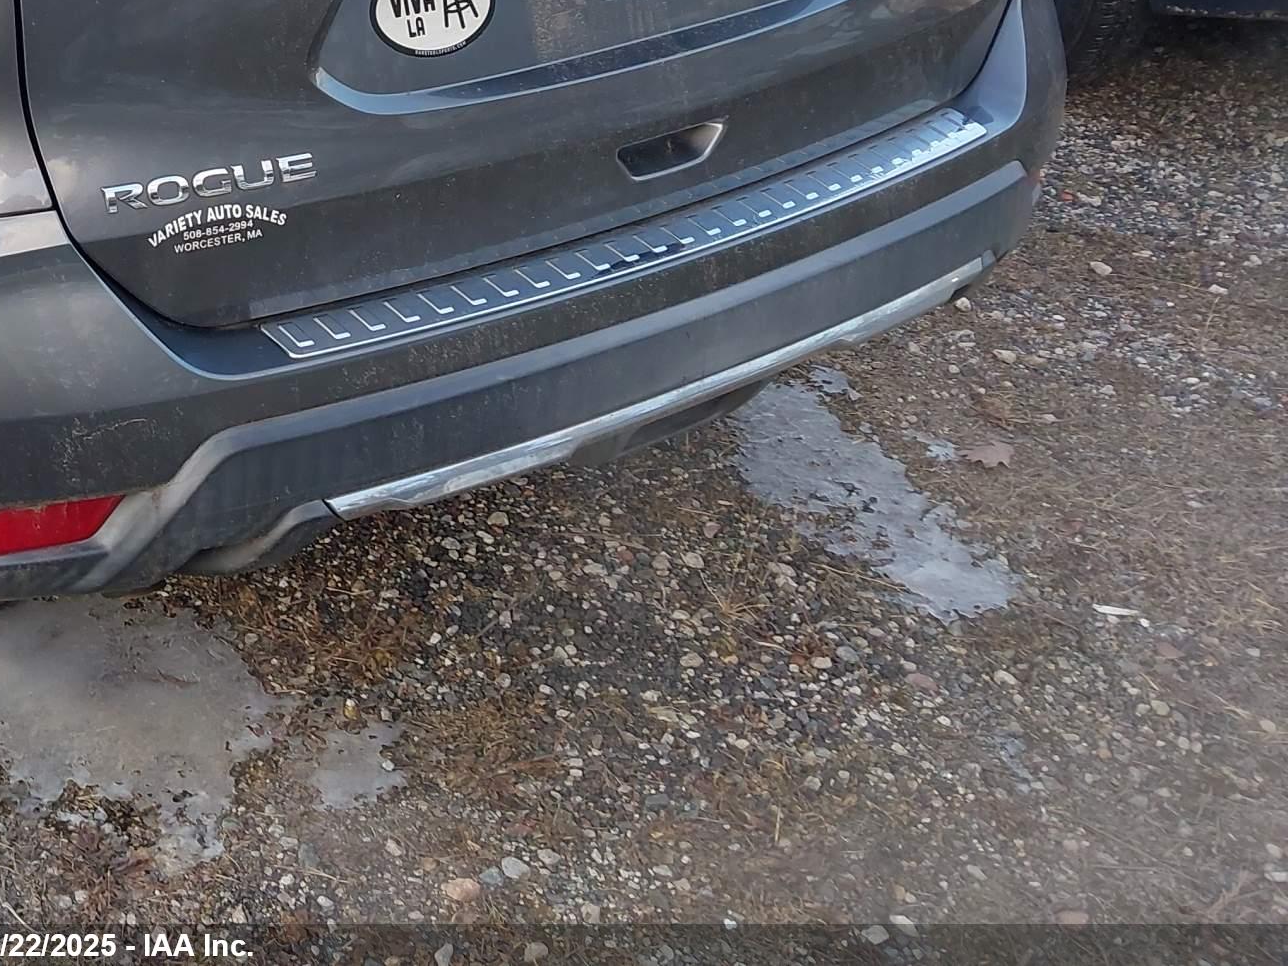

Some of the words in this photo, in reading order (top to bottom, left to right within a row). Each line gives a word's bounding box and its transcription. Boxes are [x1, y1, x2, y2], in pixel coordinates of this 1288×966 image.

[407, 16, 426, 38] LA
[101, 152, 317, 214] ROGUE
[148, 209, 202, 248] VARIETY
[206, 204, 242, 223] AUTO
[245, 204, 287, 226] SALES
[183, 219, 253, 241] 508-854-2994
[174, 232, 246, 253] WORCESTER,
[246, 228, 263, 240] MA
